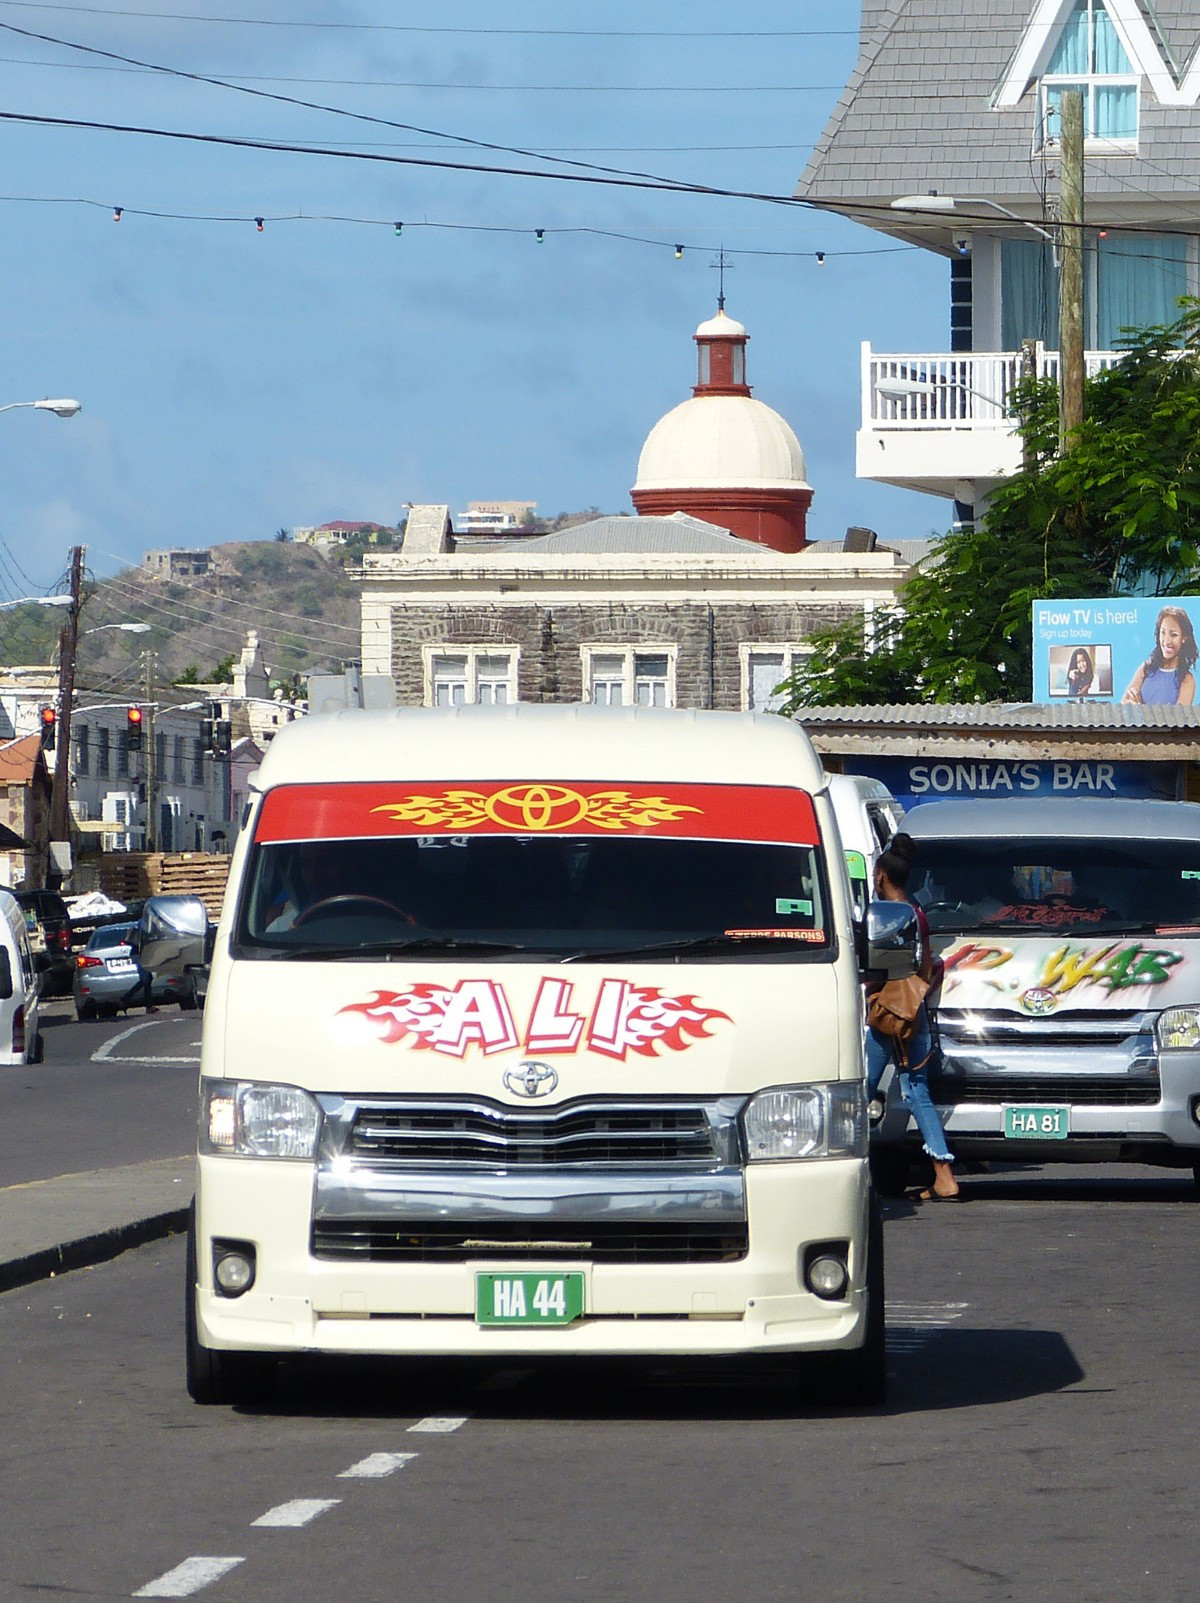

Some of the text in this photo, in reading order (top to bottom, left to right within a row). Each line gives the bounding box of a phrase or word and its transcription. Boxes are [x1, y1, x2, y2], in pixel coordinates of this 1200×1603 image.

[1039, 608, 1138, 625] Flow TV is here!
[1040, 627, 1093, 640] Sign up today
[909, 763, 1117, 792] SONIA'S BAR
[432, 976, 638, 1062] ALI
[1012, 1114, 1060, 1133] HA 81
[494, 1280, 566, 1317] HA 44
